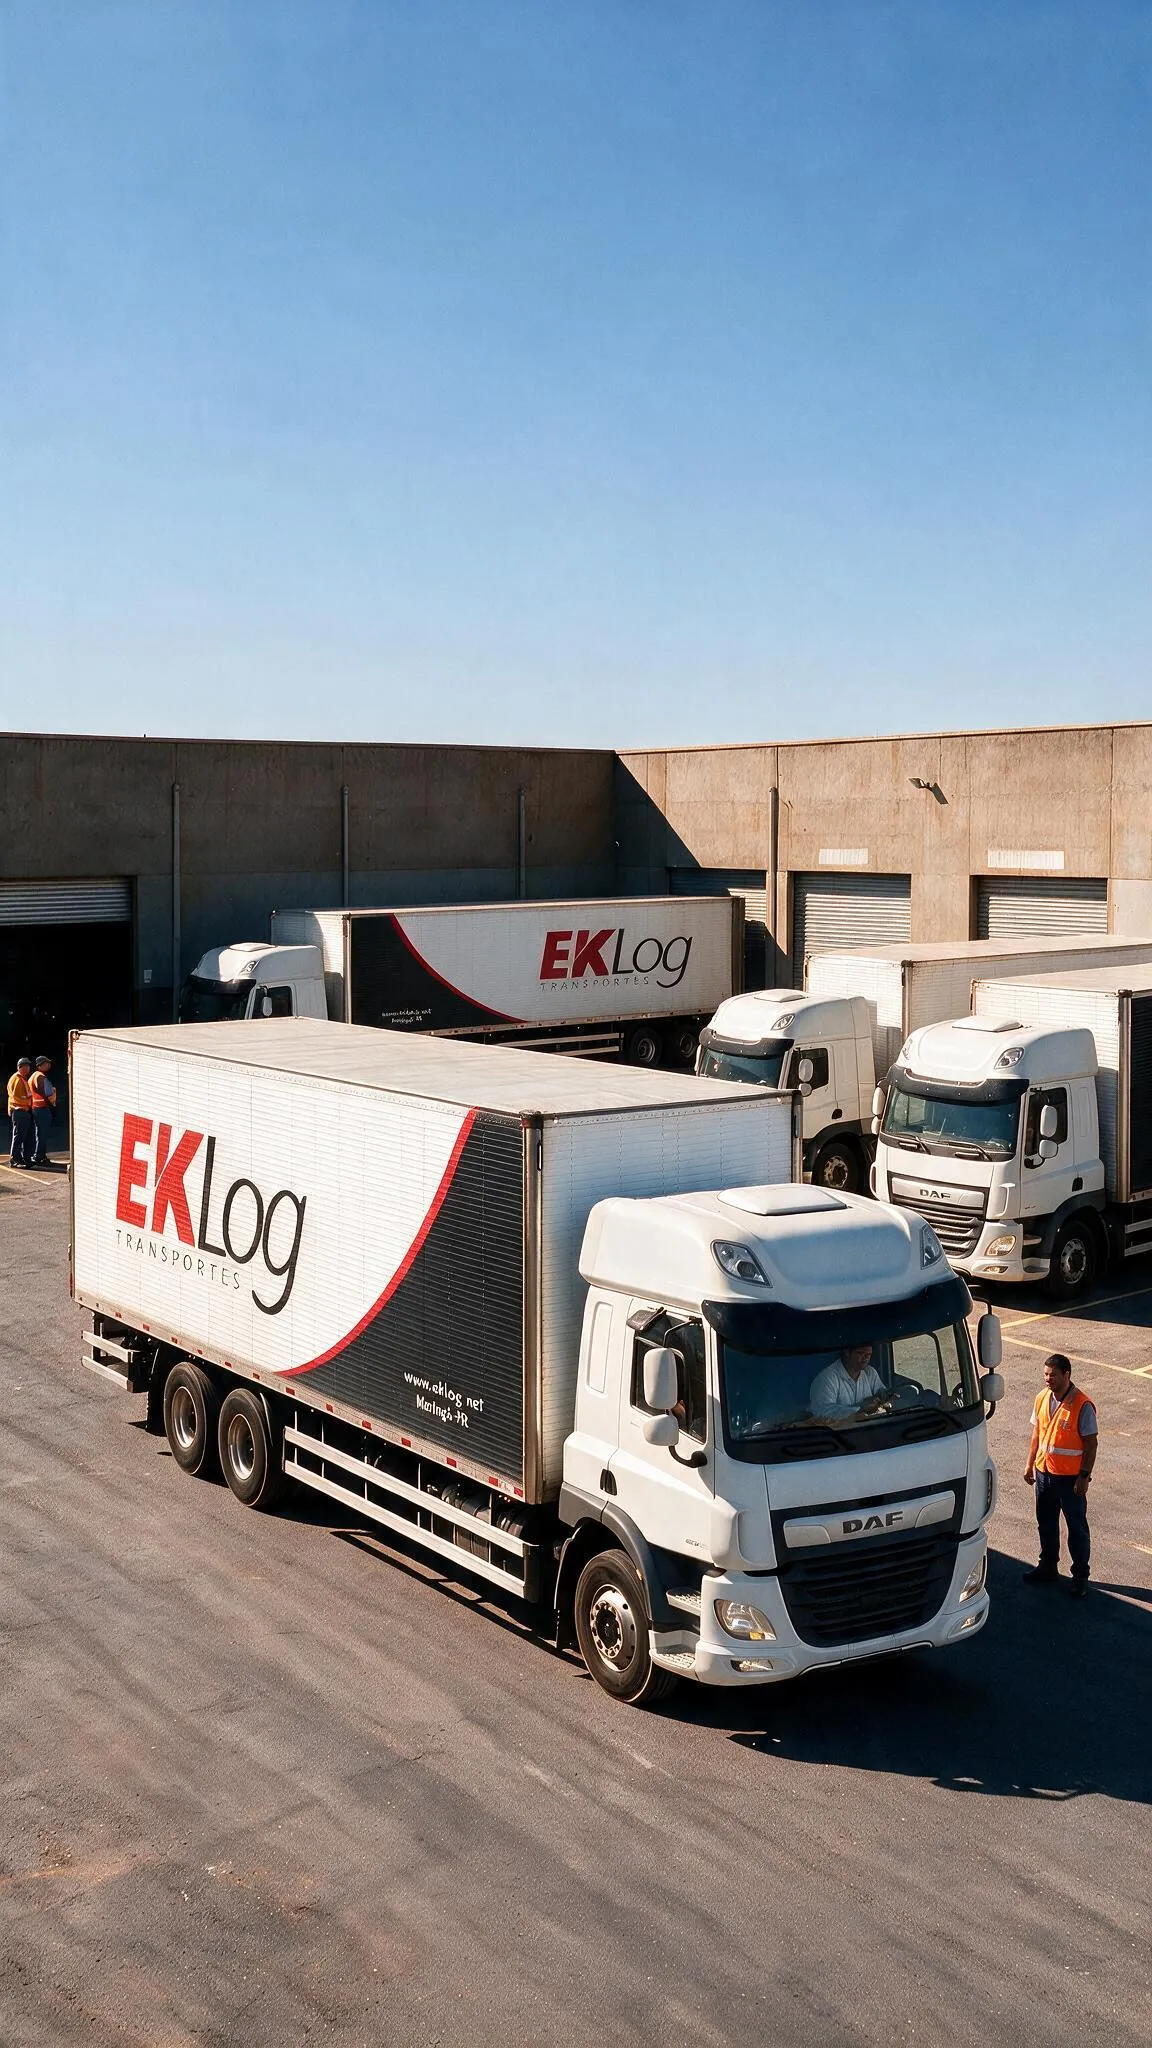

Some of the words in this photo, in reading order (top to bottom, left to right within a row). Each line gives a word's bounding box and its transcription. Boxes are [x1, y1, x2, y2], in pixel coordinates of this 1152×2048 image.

[539, 928, 693, 988] EKLog
[540, 976, 650, 992] TRANSPORTES
[116, 1112, 307, 1315] EKLog
[919, 1189, 951, 1199] DAF
[115, 1229, 241, 1290] TRANSPORTES
[842, 1511, 904, 1534] DAF
